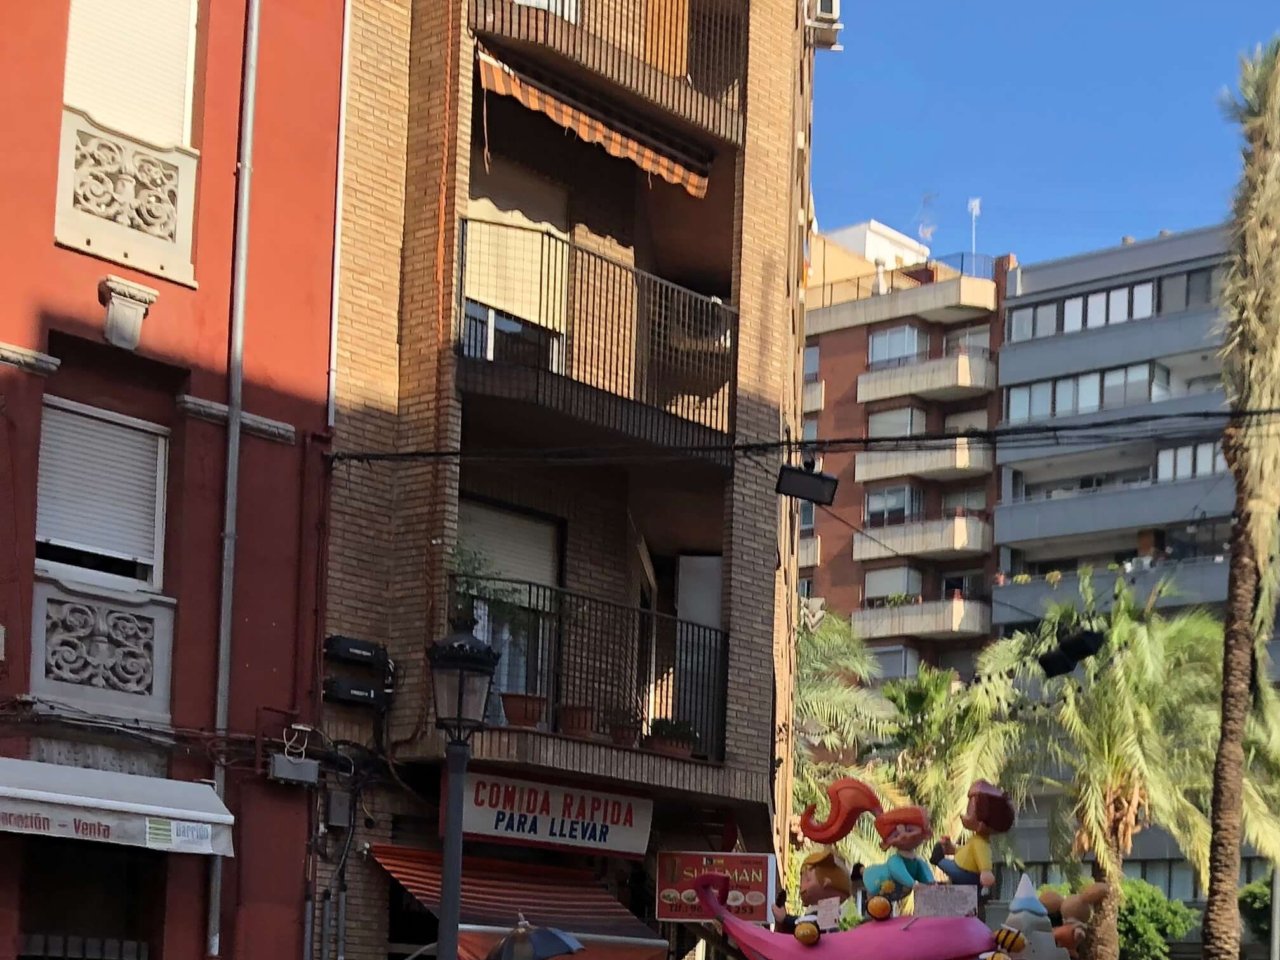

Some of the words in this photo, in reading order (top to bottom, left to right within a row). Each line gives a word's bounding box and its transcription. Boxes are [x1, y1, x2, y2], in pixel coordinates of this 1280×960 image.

[474, 780, 550, 817] COMIDA
[562, 793, 634, 828] RAPIDA
[73, 818, 111, 839] Venta
[494, 811, 538, 835] PARA
[549, 818, 609, 843] LLEVAR
